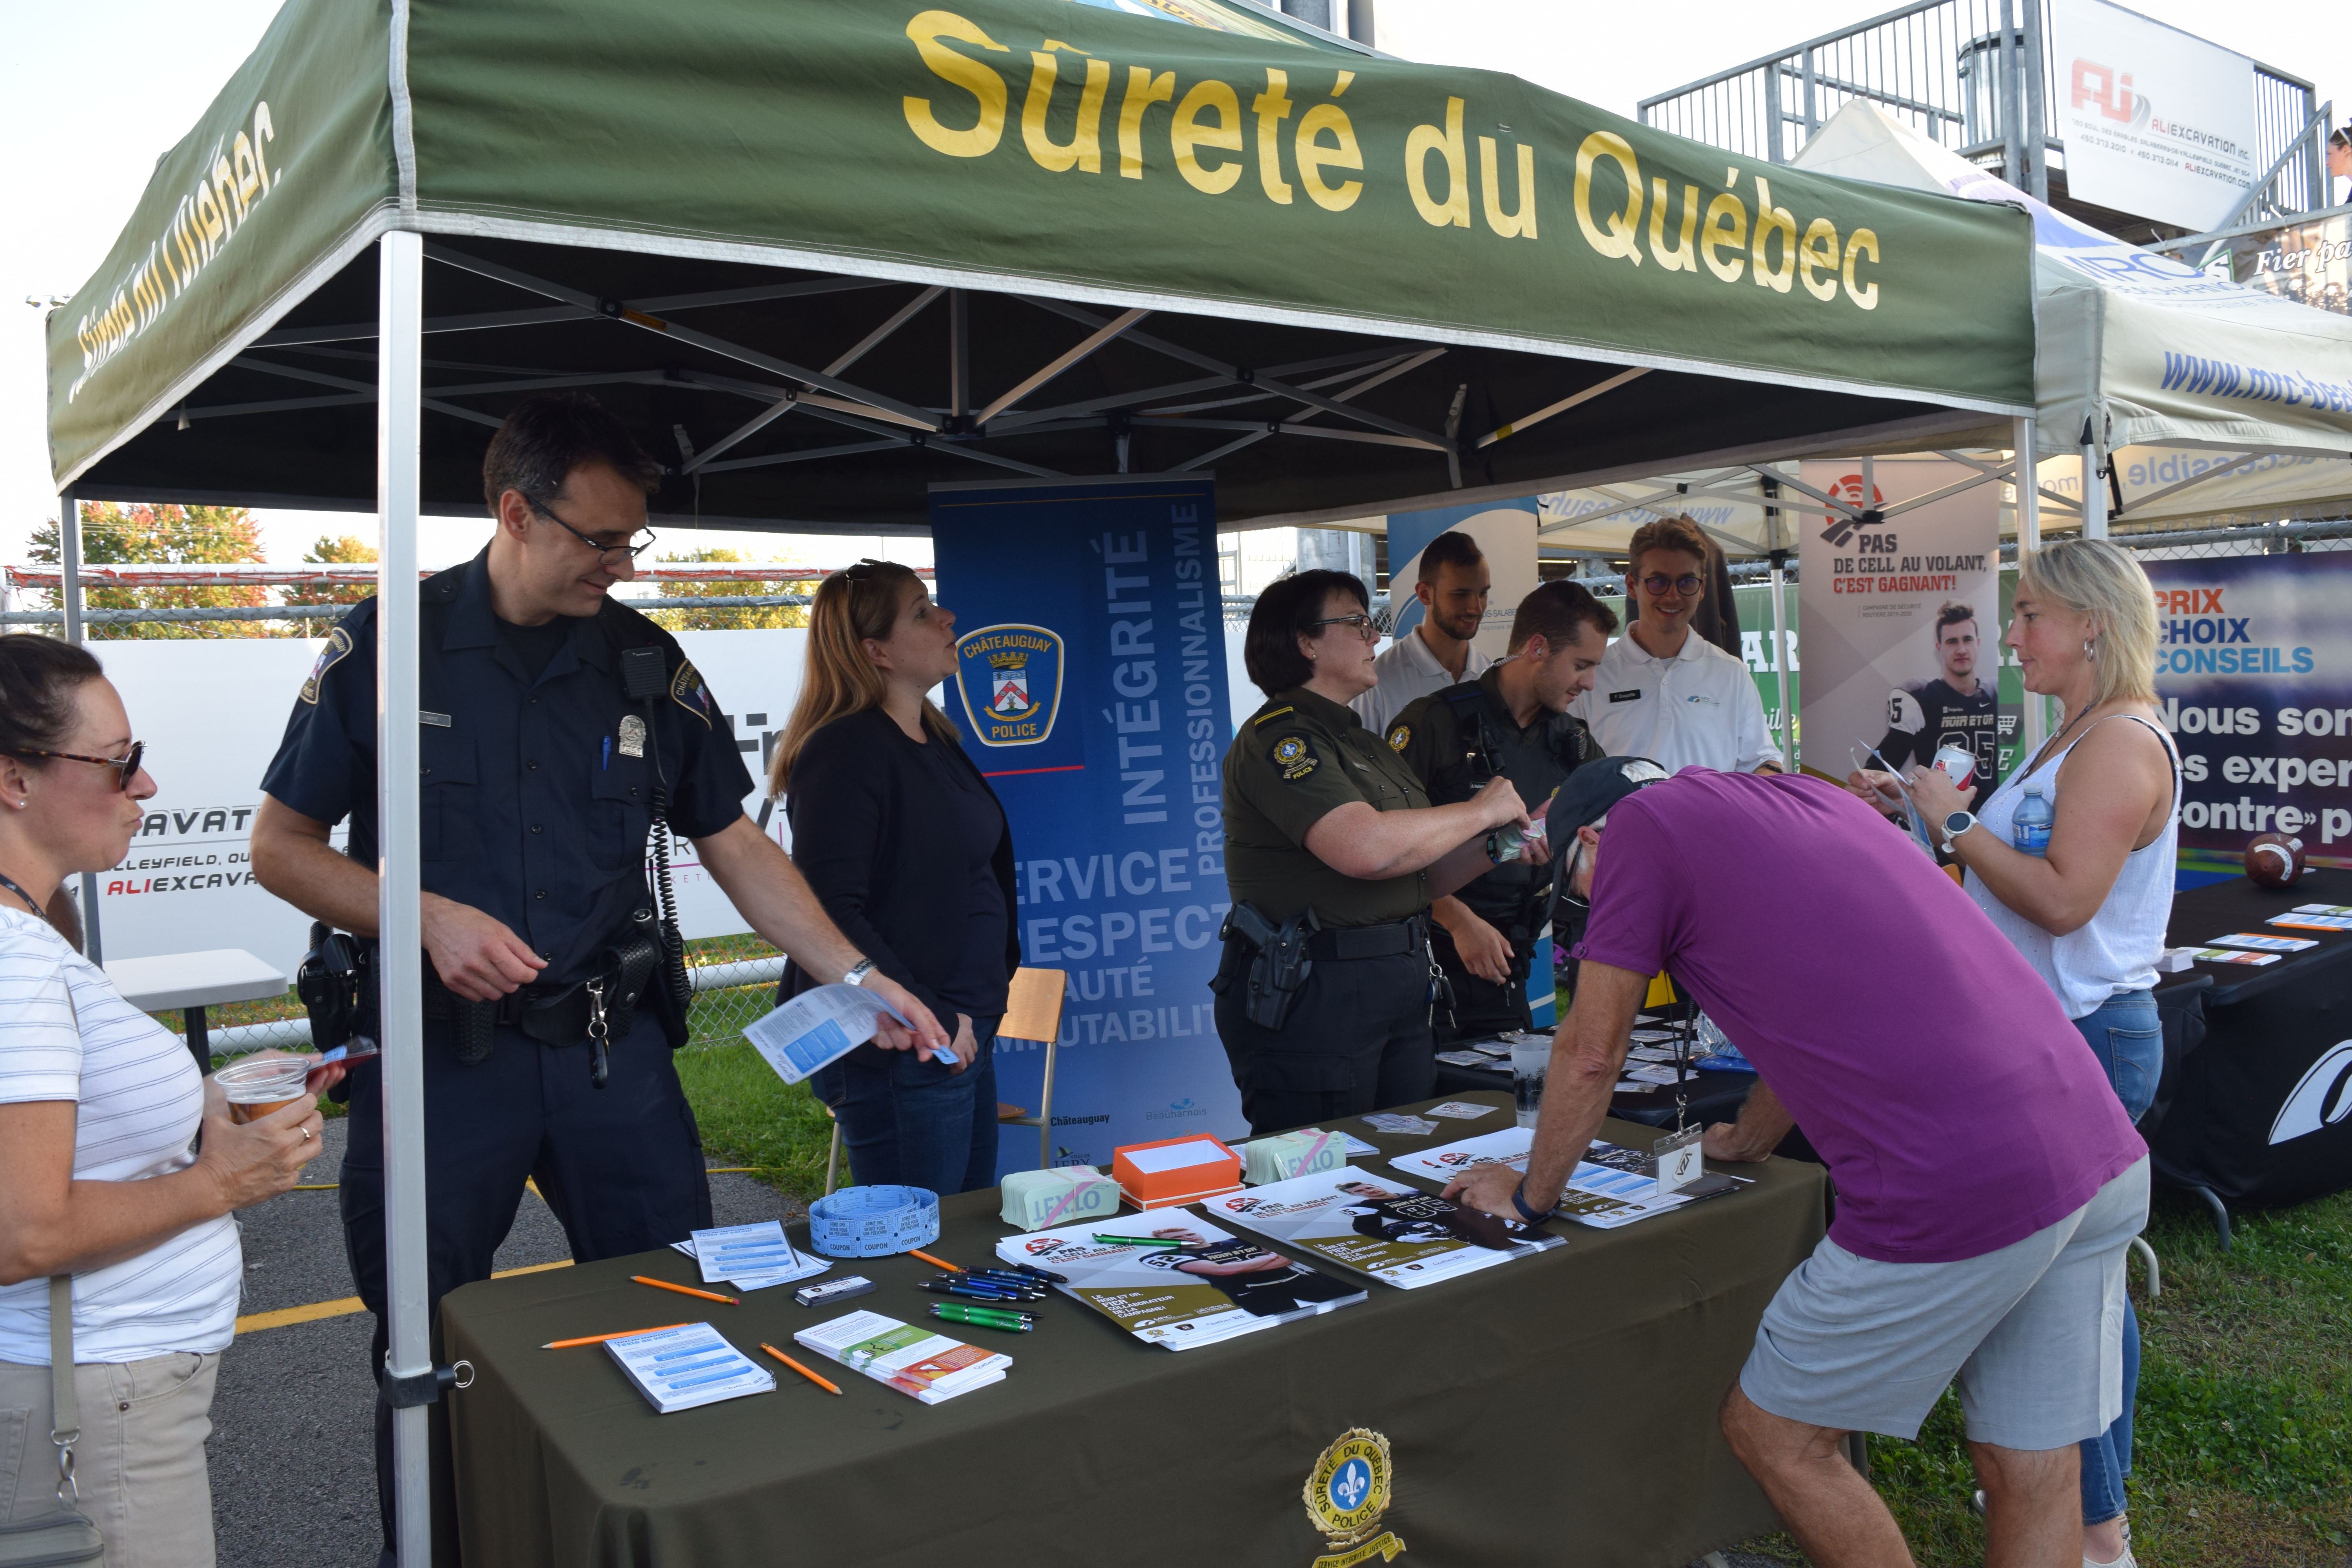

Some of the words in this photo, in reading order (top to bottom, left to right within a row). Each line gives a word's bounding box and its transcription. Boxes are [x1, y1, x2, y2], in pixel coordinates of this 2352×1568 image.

[2080, 134, 2126, 153] 450.373.2010
[2137, 150, 2179, 167] 450.373.0114
[903, 11, 1363, 211] Sûreté
[1405, 96, 1537, 238] du
[1575, 131, 1879, 310] Québec
[2056, 254, 2205, 282] MRC
[2254, 247, 2312, 276] Fier
[2160, 351, 2352, 412] www.mrc-bea
[1858, 534, 1897, 553] PAS
[1834, 558, 1854, 573] DE
[1858, 557, 1894, 572] CELL
[1900, 556, 1920, 572] AU
[1926, 555, 1987, 572] VOLANT,
[1833, 577, 1874, 593] C'EST
[1878, 575, 1956, 592] GAGNANT!
[2153, 588, 2225, 615] PRIX
[964, 635, 1053, 658] CHÂTEAUGUAY
[2154, 647, 2314, 673] CONSEILS
[1090, 530, 1167, 825] INTÉGRITÉ
[1171, 503, 1224, 876] PROFESSIONNALISME
[1941, 715, 1968, 728] NOIR
[1969, 715, 1981, 726] ET
[1982, 714, 1994, 725] OR
[2156, 697, 2260, 735] Nous
[992, 724, 1037, 738] POLICE
[1293, 766, 1313, 779] POLICE
[2180, 754, 2209, 782] s
[132, 809, 257, 837] AVAT
[1018, 902, 1234, 964] ESPECT
[1050, 1114, 1110, 1127] Châteauguay
[1146, 1107, 1207, 1120] Beauharnois
[1396, 1199, 1458, 1218] 85
[901, 1235, 921, 1246] COUPON
[1333, 1241, 1391, 1257] COLLABORATEUR
[1056, 1246, 1086, 1255] PAS
[1063, 1251, 1091, 1259] CELL
[1082, 1246, 1137, 1258] GAGNANT!
[1326, 1246, 1350, 1254] FIER
[1347, 1250, 1388, 1263] CAMPAGNE!
[1101, 1299, 1129, 1307] FIER
[1107, 1295, 1175, 1311] COLLABORATEUR
[1117, 1306, 1167, 1319] CAMPAGNE!
[1206, 1317, 1234, 1326] Québec
[655, 1331, 680, 1340] volant
[973, 1359, 996, 1370] Québec
[723, 1381, 754, 1390] Québec
[1343, 1444, 1359, 1458] DU
[1363, 1445, 1383, 1495] QUÉBEC
[1314, 1458, 1338, 1513] SÛRETÉ
[1332, 1501, 1376, 1528] POLICE
[1368, 1535, 1391, 1554] JUSTICE
[1317, 1560, 1339, 1568] SERVICE
